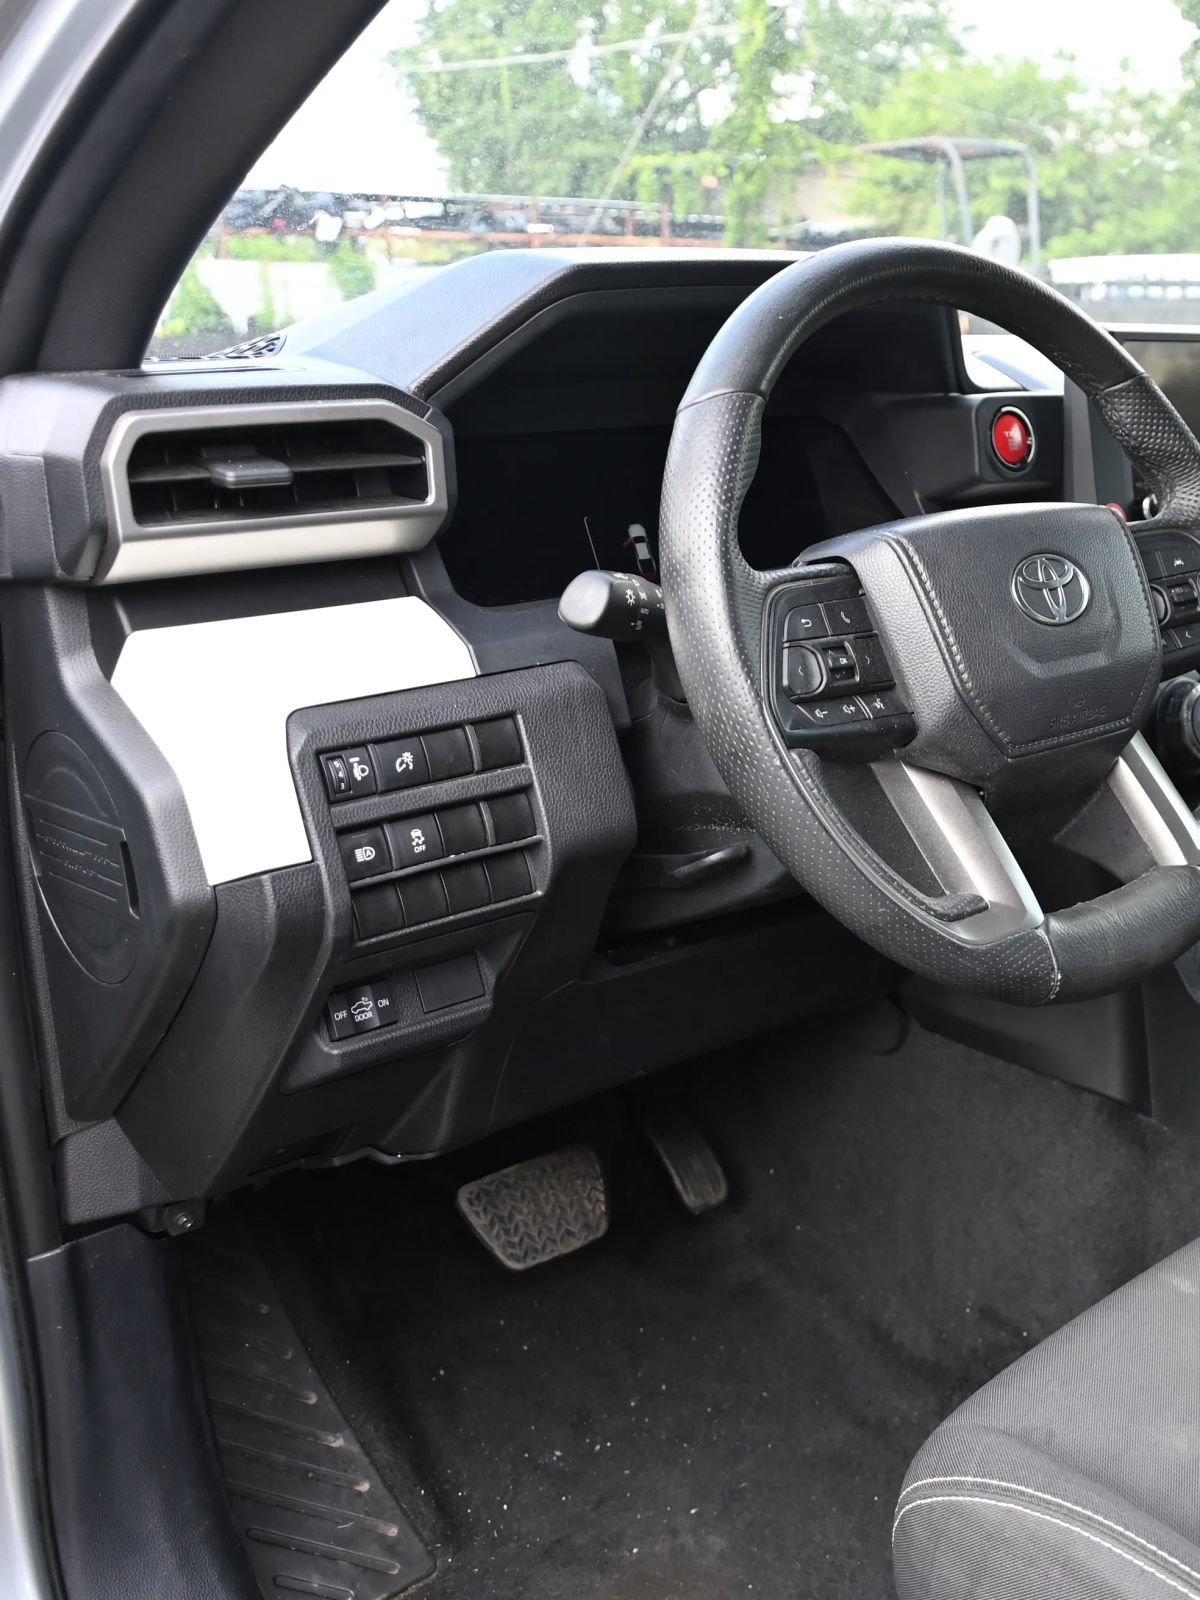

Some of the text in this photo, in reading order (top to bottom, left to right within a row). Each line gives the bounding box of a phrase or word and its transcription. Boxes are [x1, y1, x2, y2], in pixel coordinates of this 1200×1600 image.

[414, 844, 427, 854] OFF
[377, 998, 390, 1008] ON
[334, 1010, 348, 1021] OFF
[355, 1011, 373, 1022] DOOR
